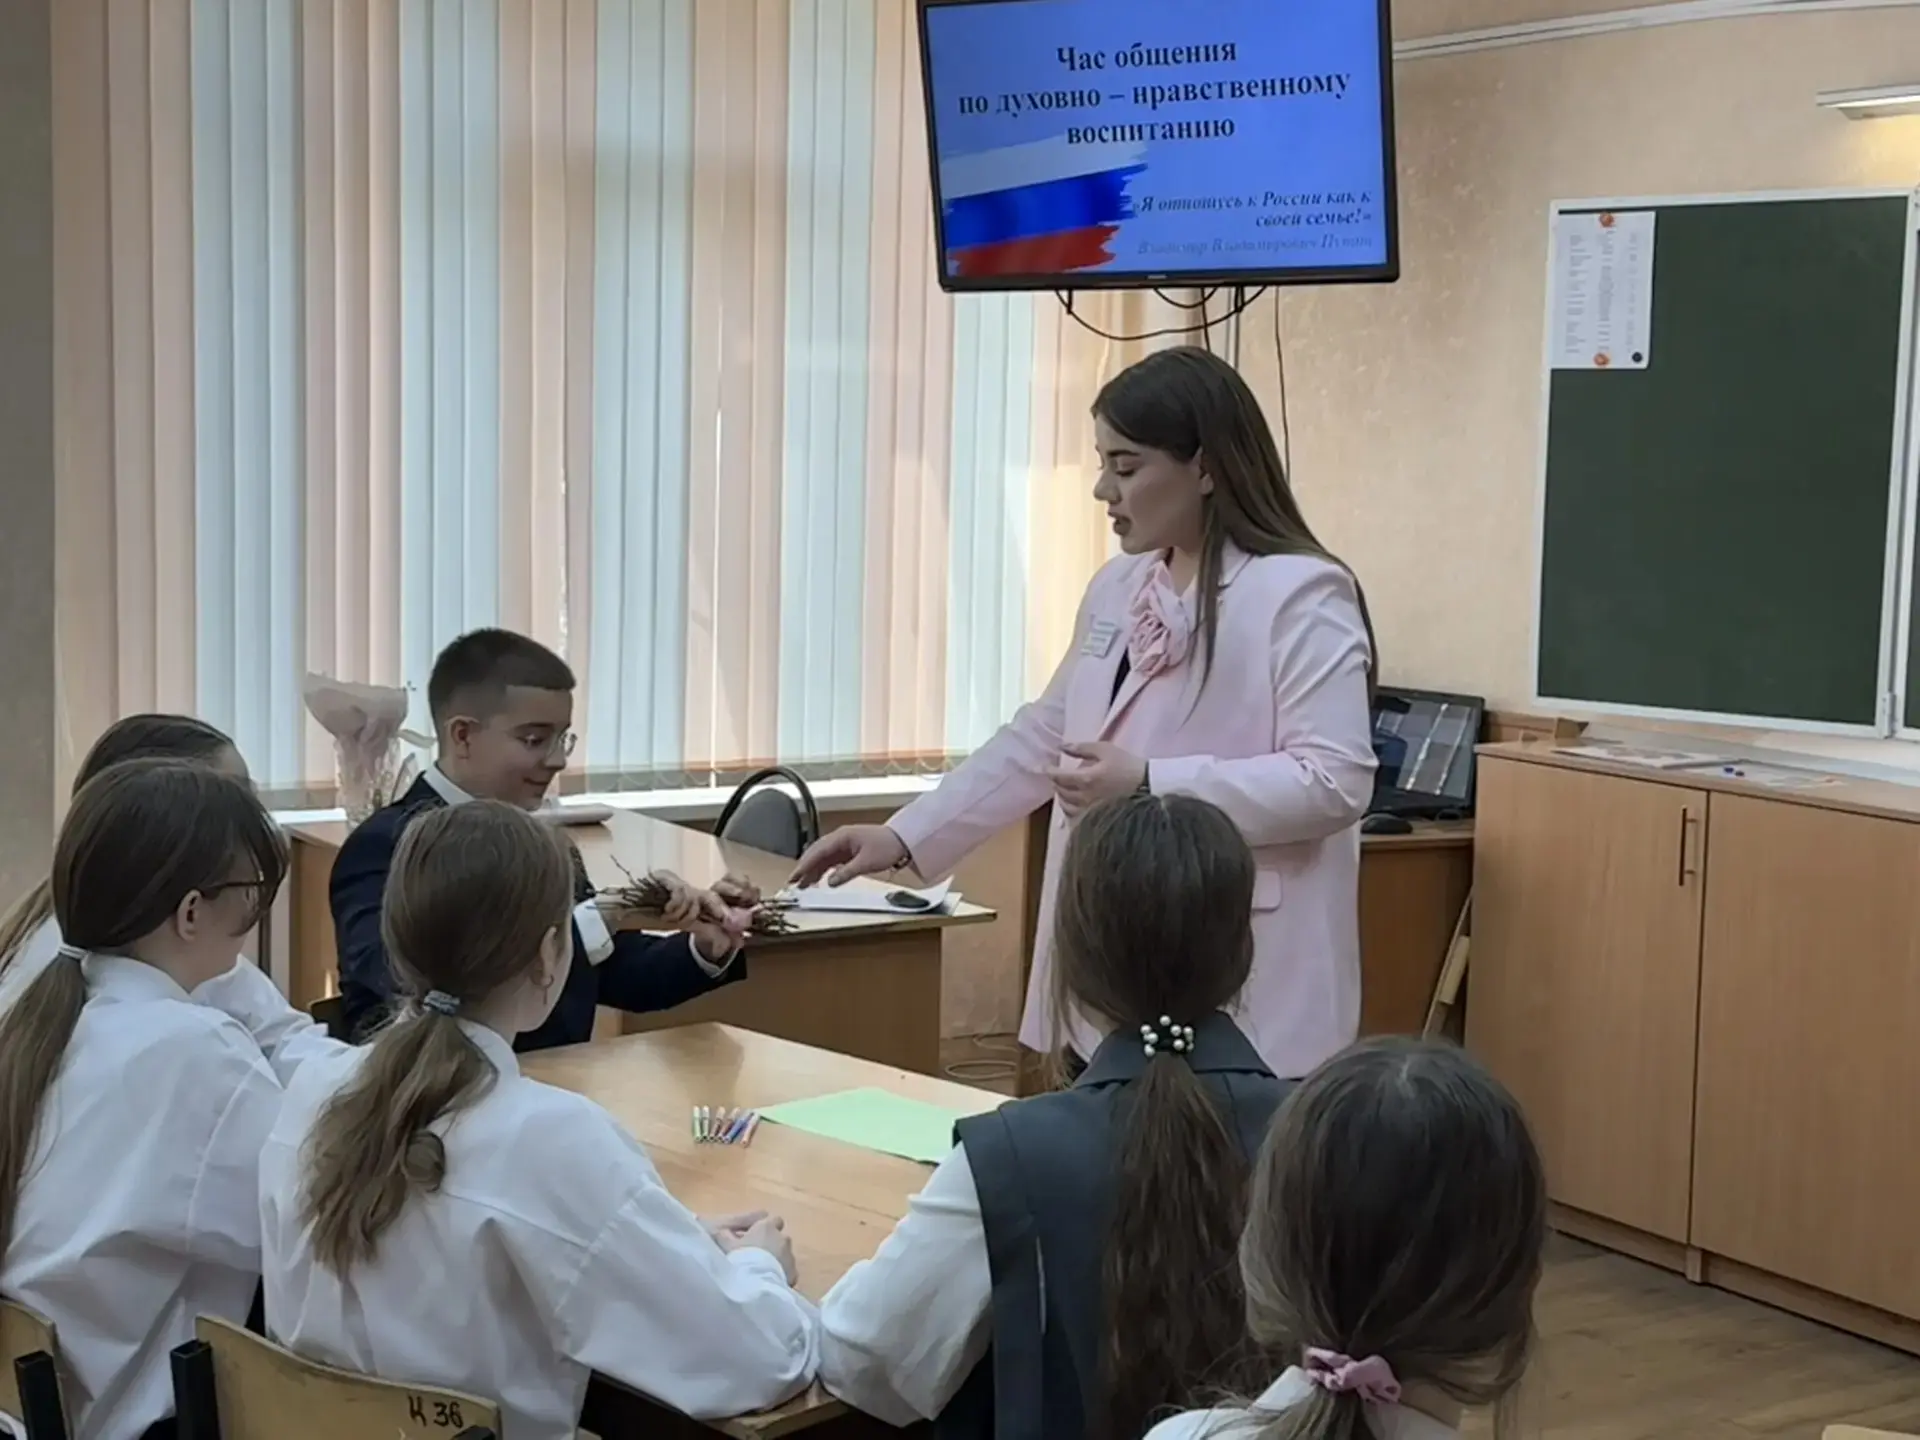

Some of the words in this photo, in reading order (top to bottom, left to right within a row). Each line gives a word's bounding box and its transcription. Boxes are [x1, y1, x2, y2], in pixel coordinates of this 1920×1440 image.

[1056, 46, 1106, 71] Час
[1115, 42, 1236, 68] общения
[959, 95, 989, 114] по
[996, 88, 1101, 118] духовно
[1132, 73, 1350, 110] нравственному
[1067, 118, 1235, 144] воспитанию
[1262, 191, 1322, 207] России
[1327, 191, 1356, 204] как
[1361, 190, 1372, 203] к
[433, 1401, 464, 1429] 36
